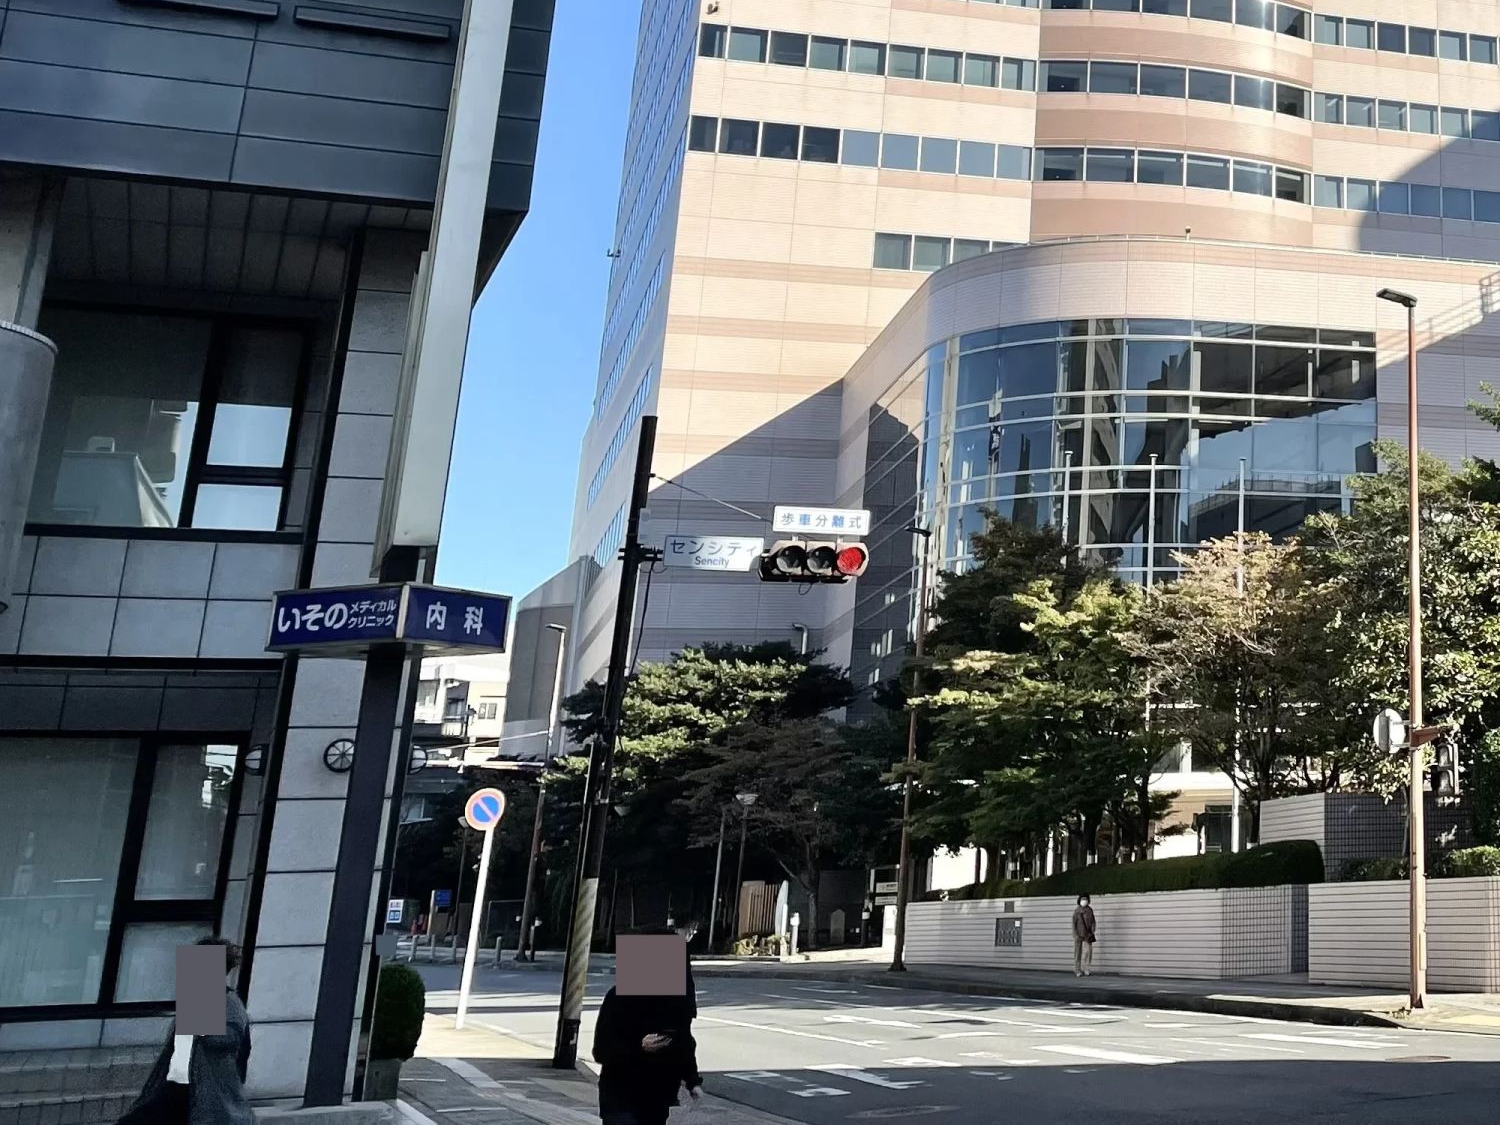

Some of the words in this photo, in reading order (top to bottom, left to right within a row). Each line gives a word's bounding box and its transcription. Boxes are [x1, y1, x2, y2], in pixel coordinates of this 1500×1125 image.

[781, 512, 862, 530] 歩車分離式
[670, 539, 758, 556] センシティ
[694, 555, 730, 568] Sencity
[349, 599, 398, 614] メディカル
[277, 602, 348, 633] いその
[347, 614, 395, 629] クリニック
[425, 601, 484, 636] 内科
